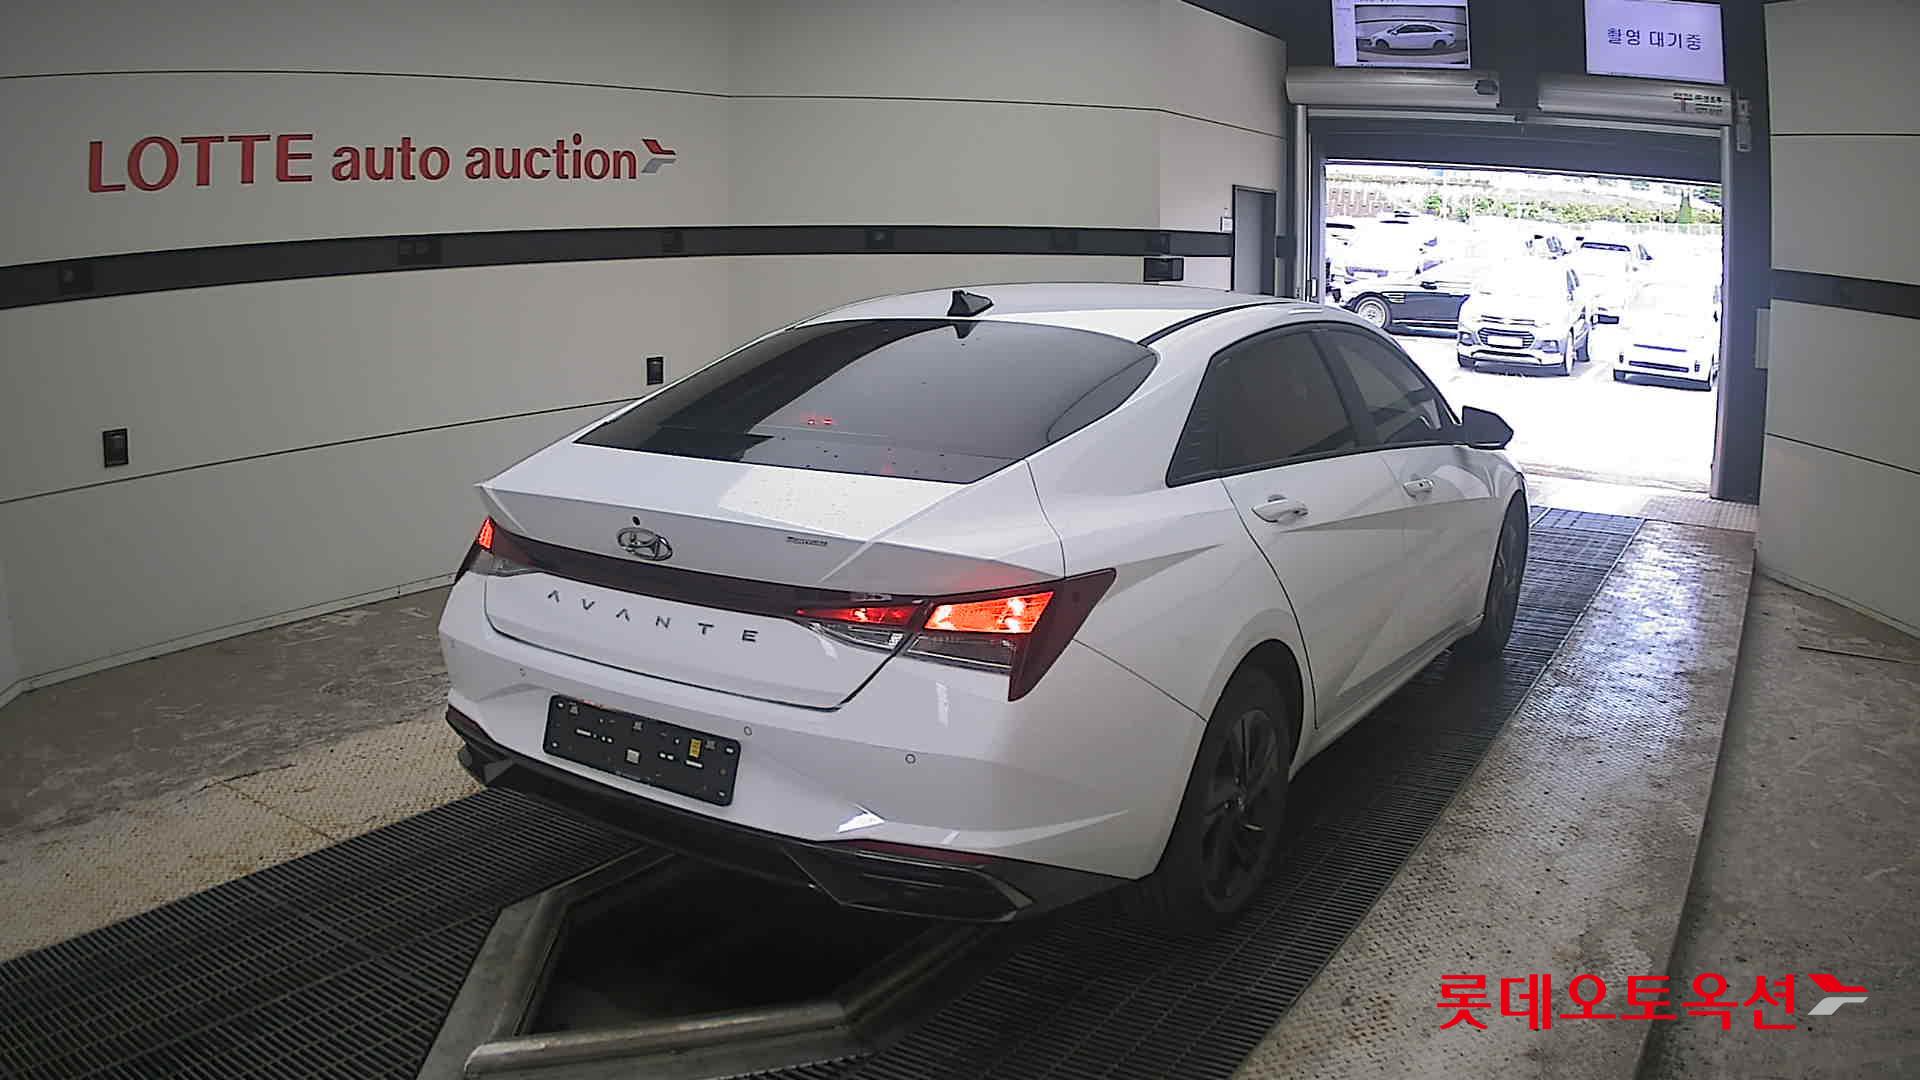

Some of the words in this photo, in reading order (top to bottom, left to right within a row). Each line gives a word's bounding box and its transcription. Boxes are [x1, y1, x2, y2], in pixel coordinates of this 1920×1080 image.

[1607, 27, 1641, 46] 촬영
[1649, 31, 1702, 51] 대기중
[89, 133, 314, 193] LOTTE
[331, 136, 451, 182] auto
[464, 133, 639, 181] auction
[547, 589, 759, 642] AVANTE
